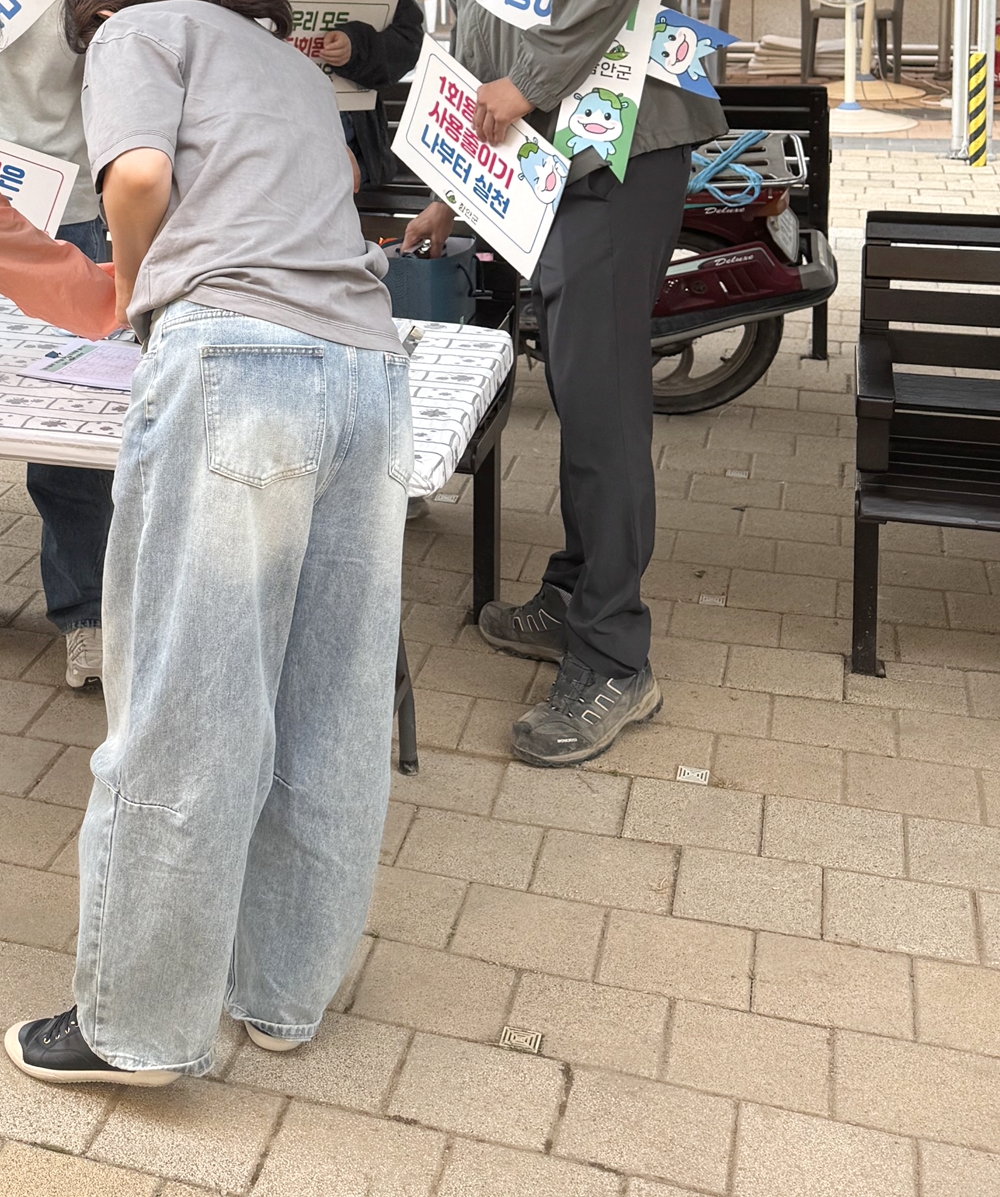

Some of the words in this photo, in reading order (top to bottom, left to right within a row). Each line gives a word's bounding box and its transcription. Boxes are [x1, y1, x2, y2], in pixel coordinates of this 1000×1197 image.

[428, 101, 515, 190] 사용줄이기
[421, 124, 473, 185] 나부터
[473, 174, 511, 219] 실천
[704, 205, 746, 215] Deluxe
[714, 253, 754, 267] Deluxe
